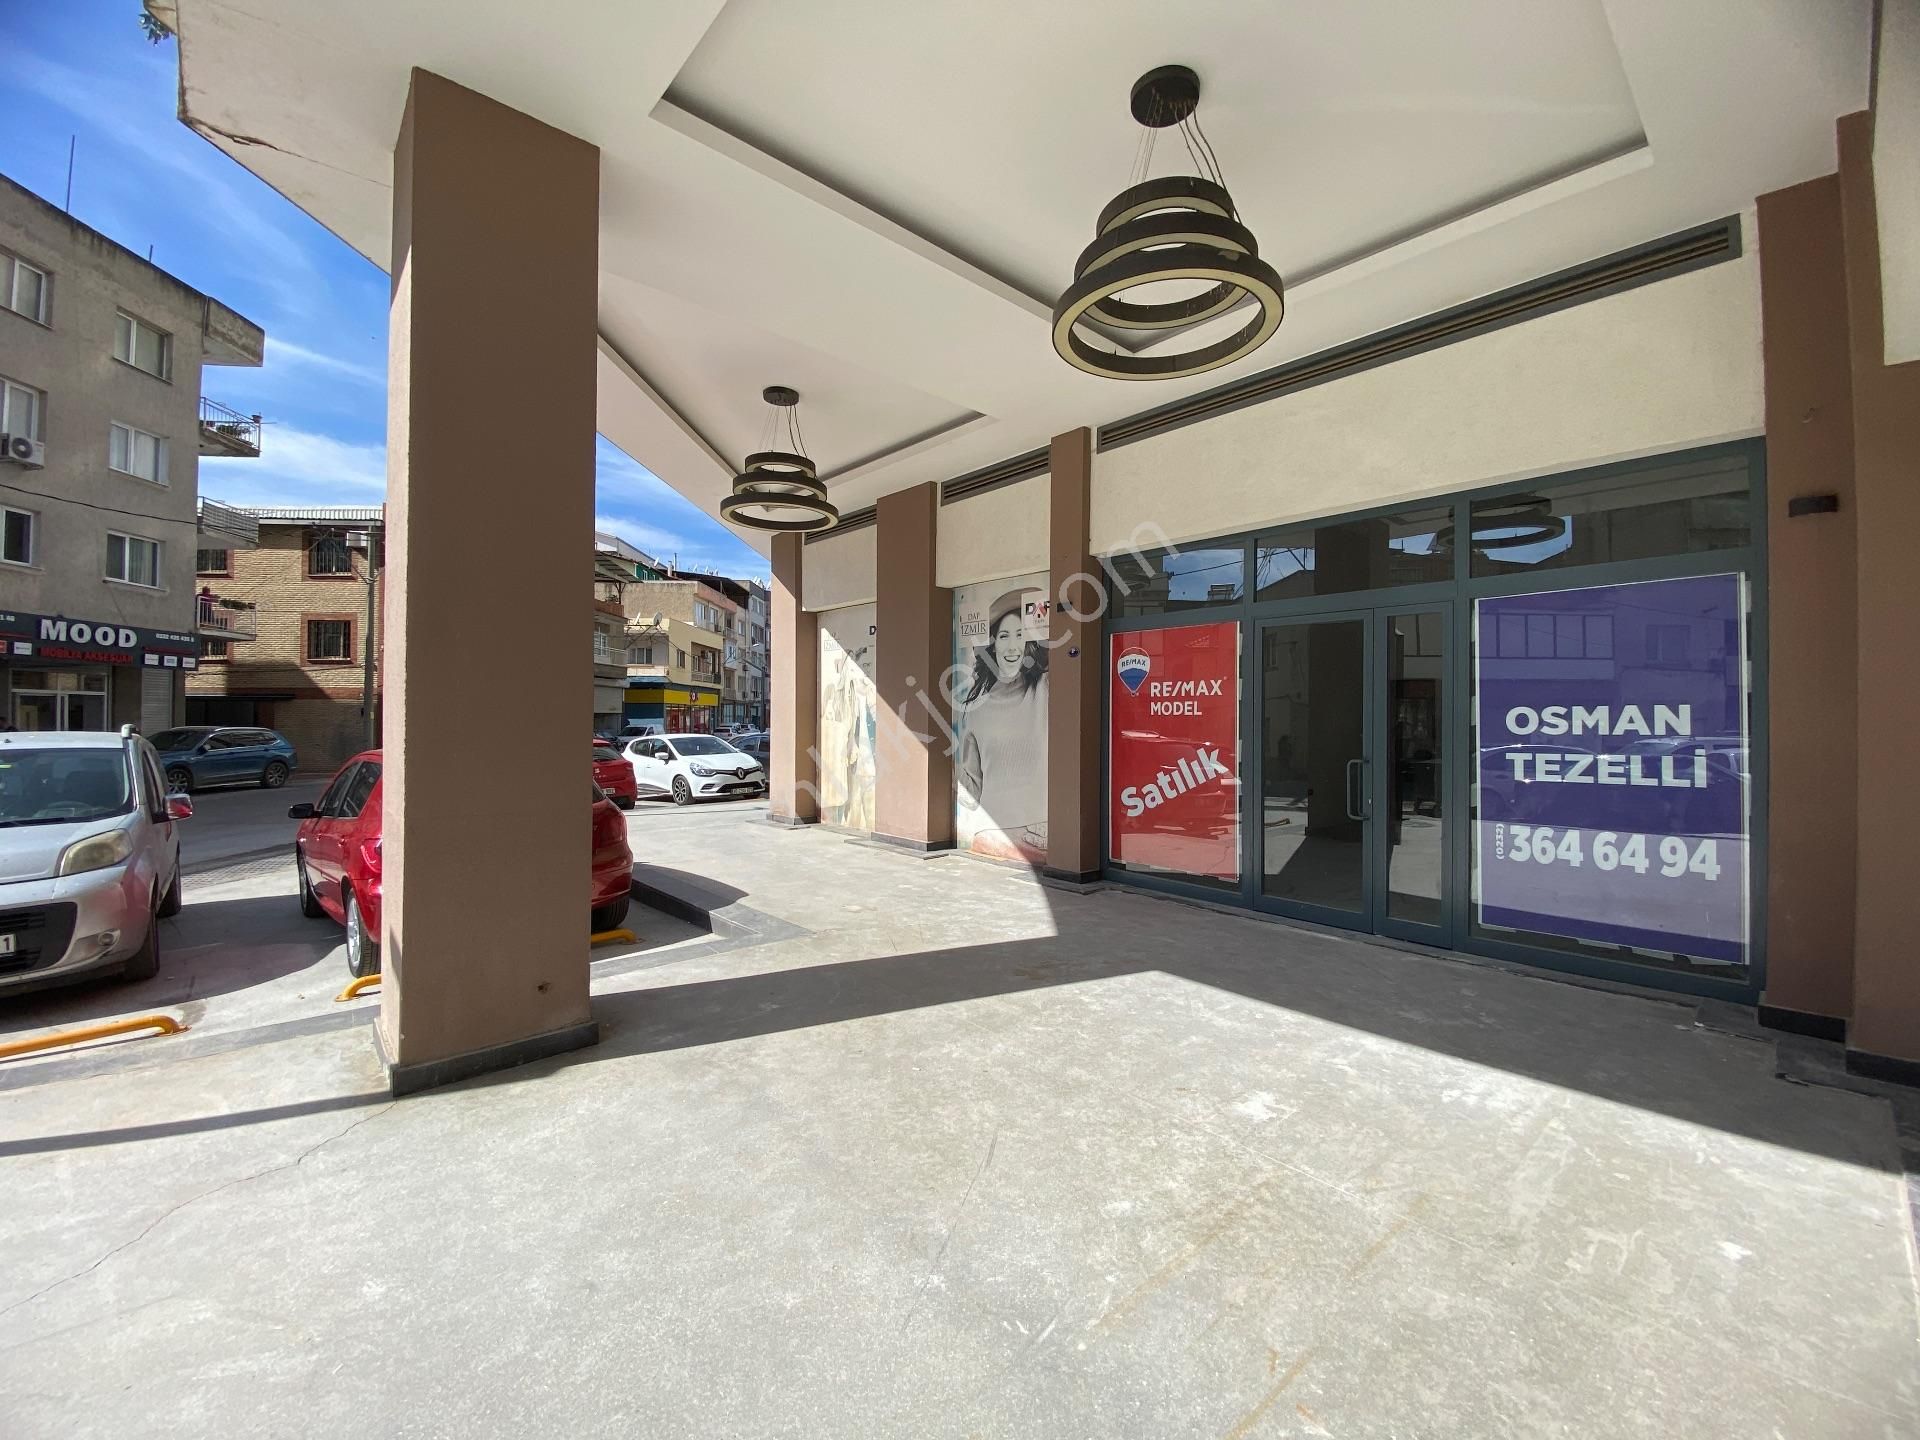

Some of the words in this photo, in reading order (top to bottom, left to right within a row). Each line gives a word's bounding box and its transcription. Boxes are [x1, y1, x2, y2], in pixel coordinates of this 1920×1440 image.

[40, 618, 138, 648] MOOD
[1121, 658, 1147, 668] RE/MAX
[1150, 679, 1223, 697] RE/MAX
[1150, 701, 1203, 716] MODEL
[1505, 704, 1692, 736] OSMAN
[1120, 747, 1230, 818] Satılık
[1505, 748, 1708, 788] TEZELLİ
[1495, 823, 1504, 860] (0232)
[1508, 825, 1584, 868] 364
[1592, 832, 1650, 875] 64
[1659, 835, 1721, 881] 94
